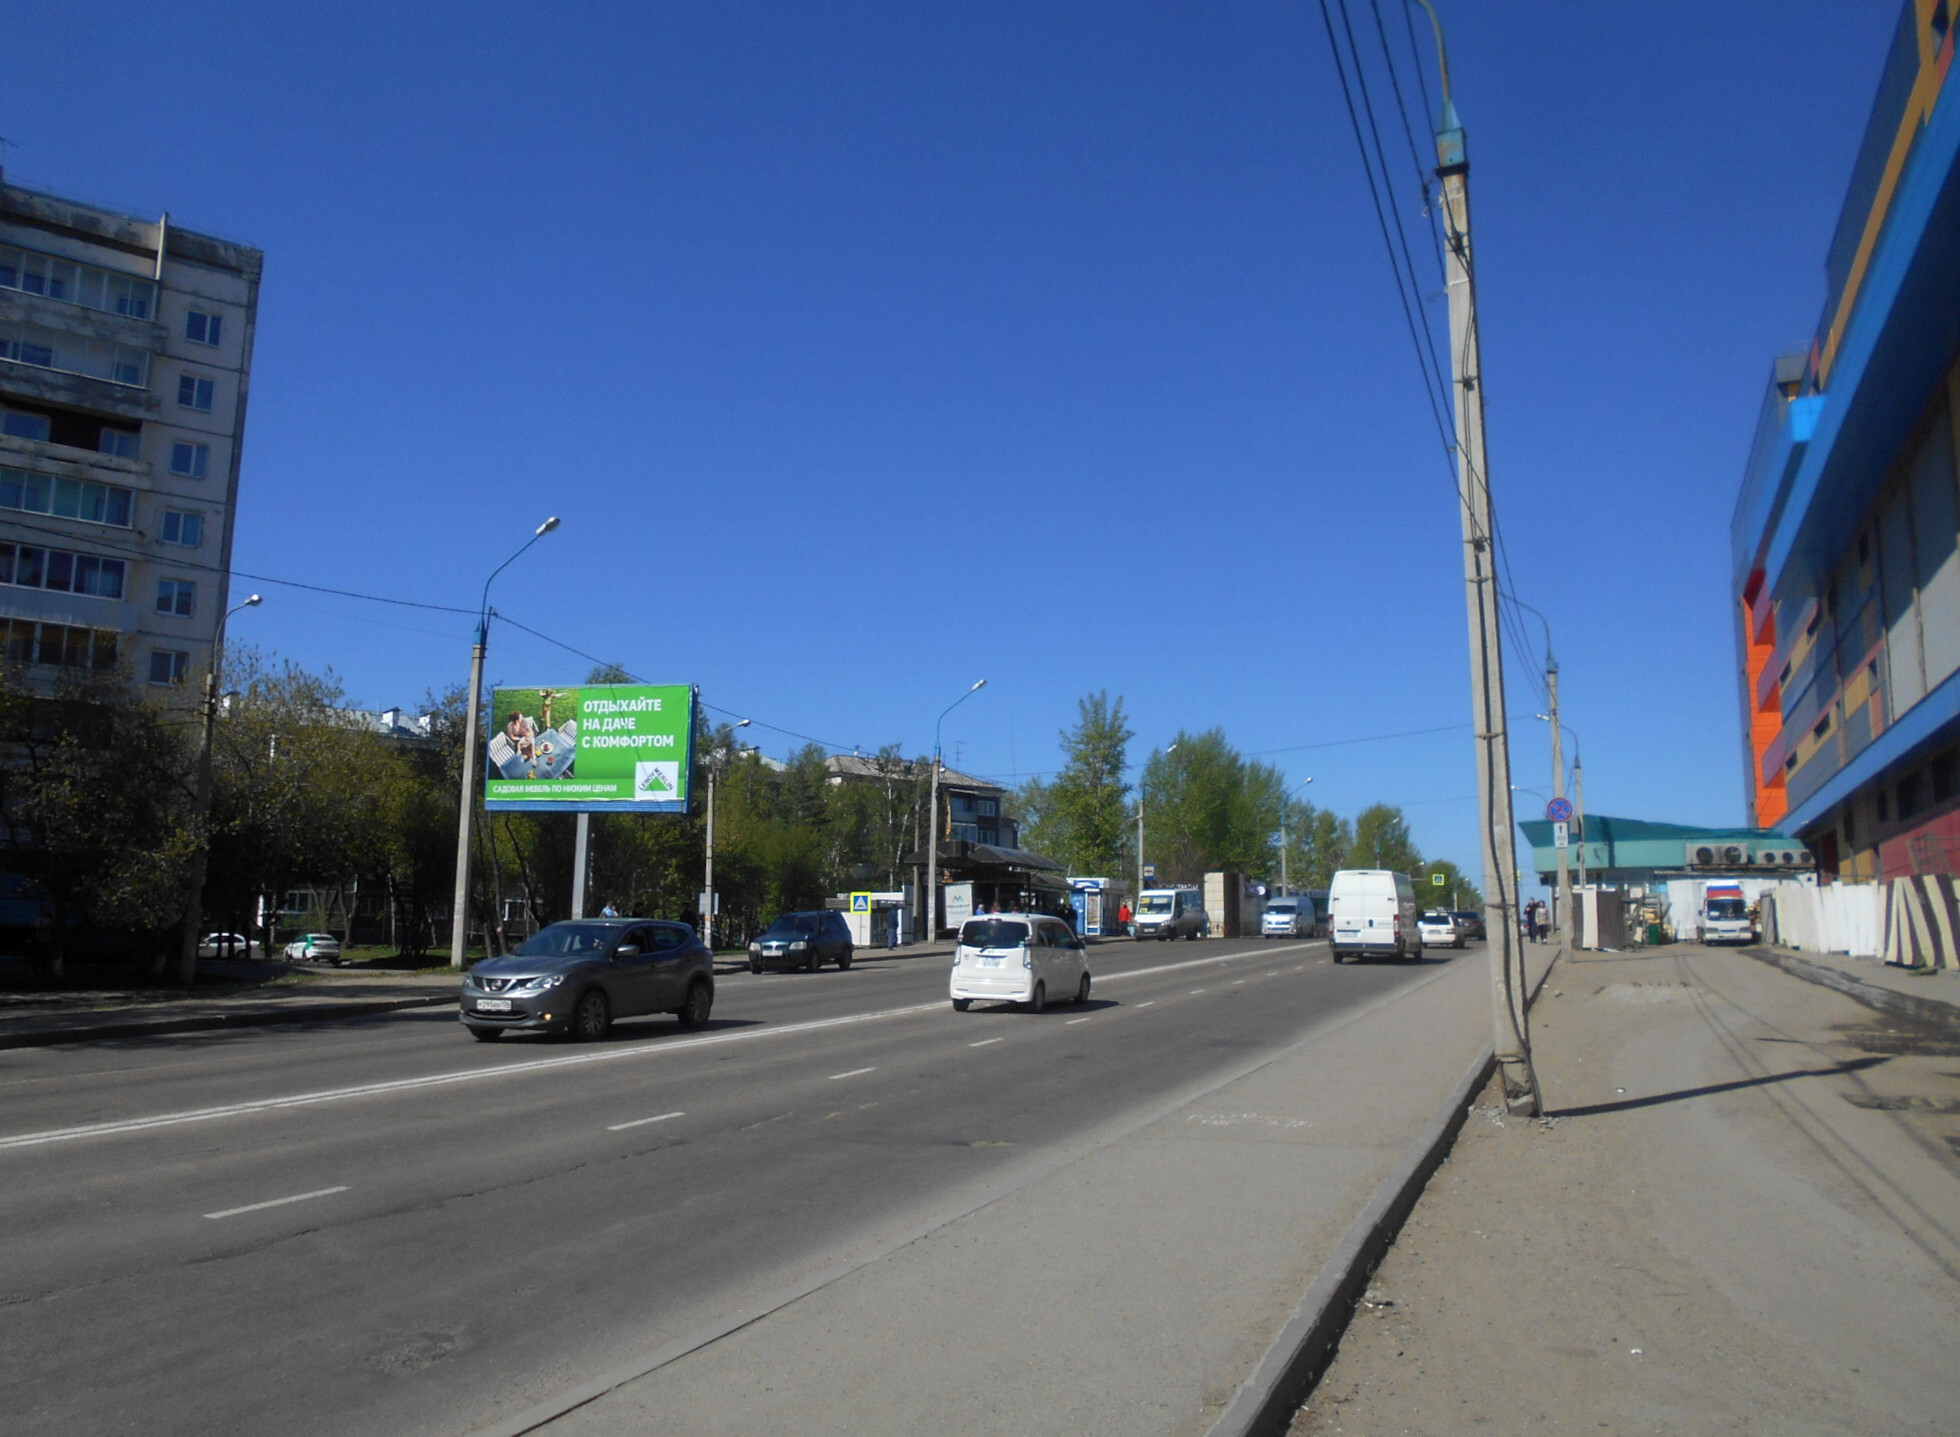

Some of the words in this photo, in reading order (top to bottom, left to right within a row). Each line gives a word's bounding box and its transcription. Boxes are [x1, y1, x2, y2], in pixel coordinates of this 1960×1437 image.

[583, 696, 662, 714] ОТДЫХАЙТЕ
[583, 718, 600, 730] НА
[602, 717, 636, 732] ДАЧЕ
[582, 736, 591, 748] С
[593, 735, 674, 748] КОМФОРТОМ
[638, 772, 656, 791] LEROY
[654, 767, 674, 791] MERLIN
[493, 784, 524, 794] САДОВАЯ
[525, 784, 551, 793] МЕБЕЛЬ
[551, 784, 562, 792] ПО
[563, 784, 591, 793] НИЗКИМ
[592, 784, 618, 793] ЦЕНАМ
